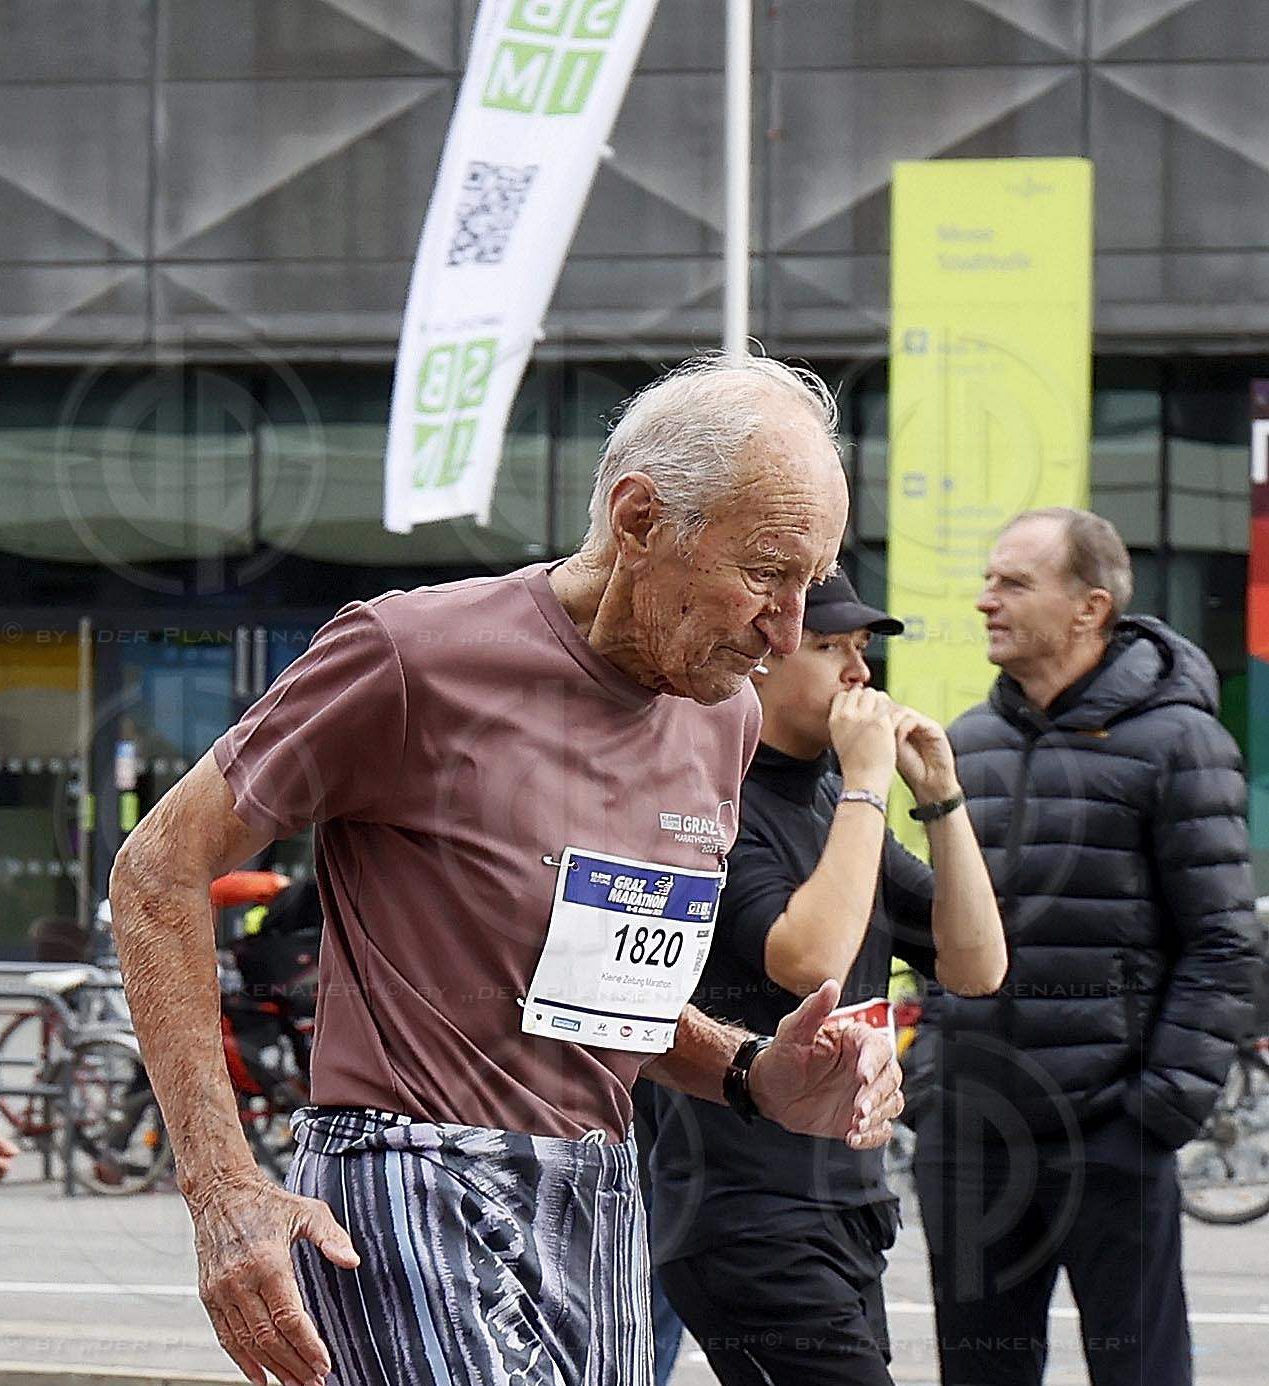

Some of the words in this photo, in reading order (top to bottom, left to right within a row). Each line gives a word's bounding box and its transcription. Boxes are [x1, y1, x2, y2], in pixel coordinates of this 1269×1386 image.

[683, 816, 718, 835] GRAZ
[614, 875, 647, 893] GRAZ
[607, 887, 669, 910] MARATHON
[614, 923, 684, 969] 1820
